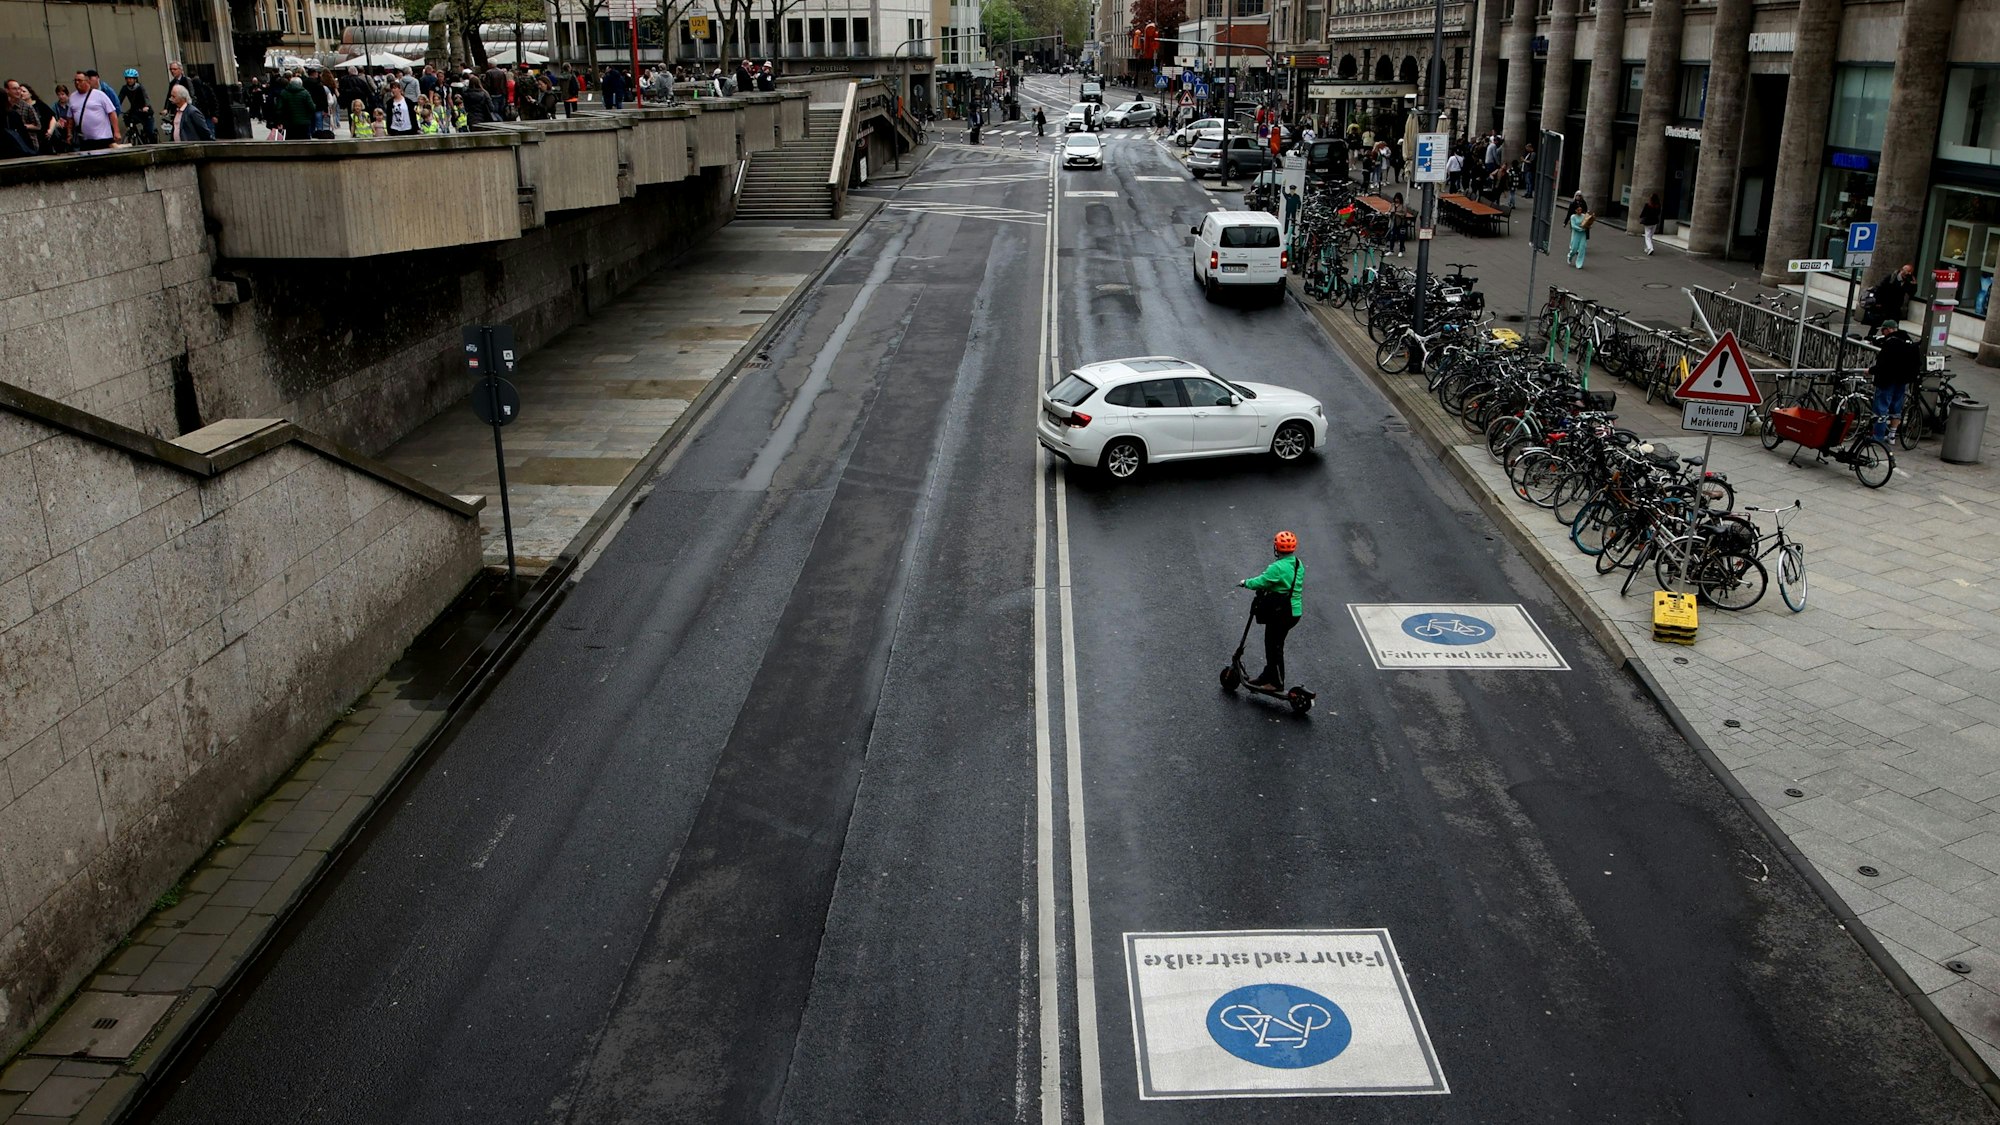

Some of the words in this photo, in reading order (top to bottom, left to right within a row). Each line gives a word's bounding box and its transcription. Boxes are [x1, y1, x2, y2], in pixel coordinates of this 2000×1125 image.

[813, 64, 850, 72] OUVENIRS
[1853, 226, 1871, 249] P
[1698, 405, 1735, 417] fehlende
[1690, 417, 1738, 431] Markierung
[1381, 650, 1548, 660] Fahrradstraße
[1144, 950, 1384, 970] Fahrradstraße
